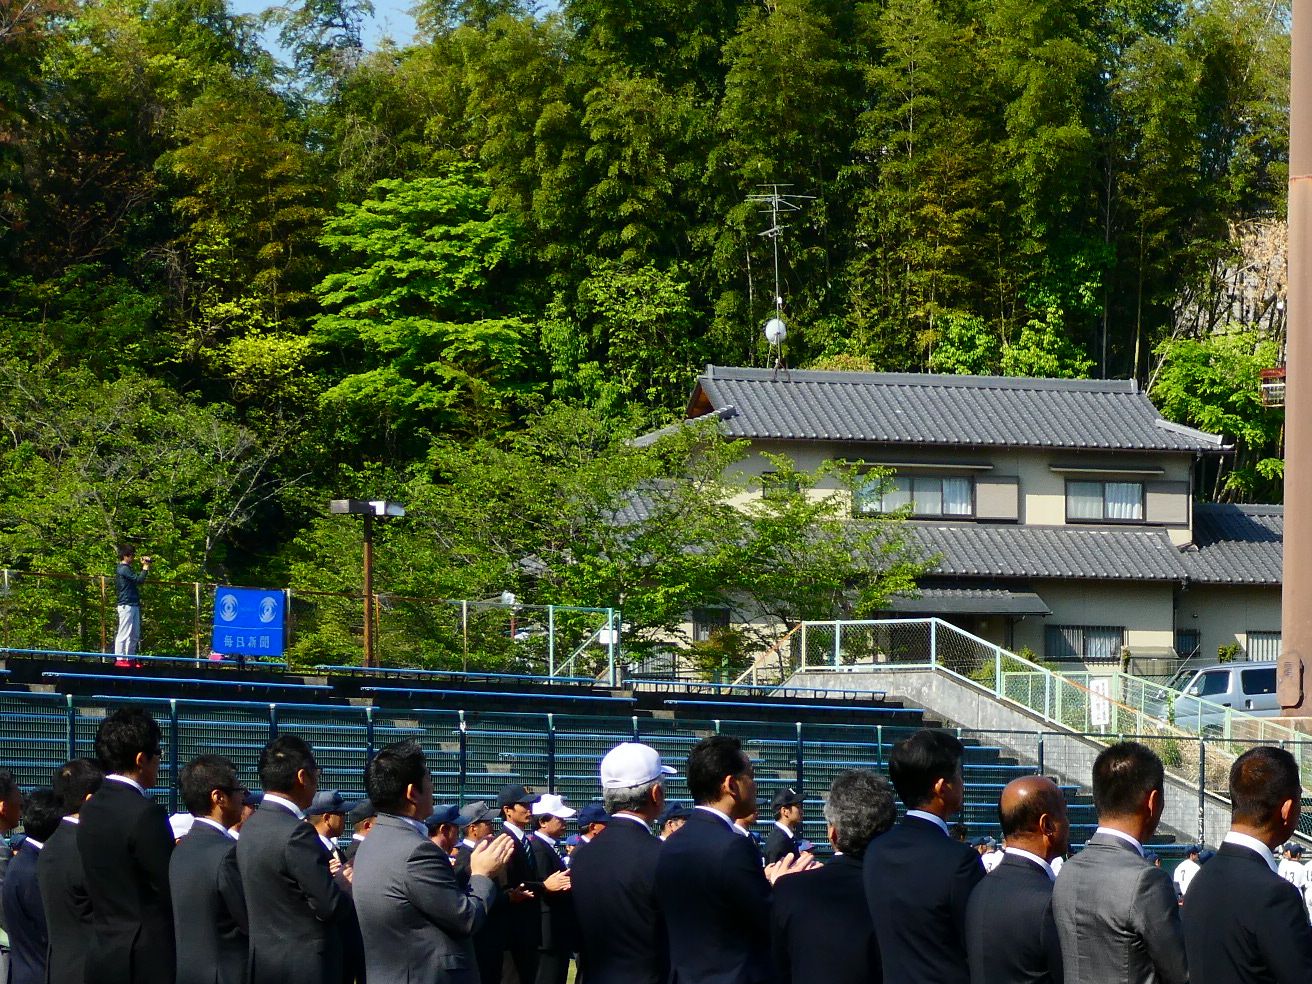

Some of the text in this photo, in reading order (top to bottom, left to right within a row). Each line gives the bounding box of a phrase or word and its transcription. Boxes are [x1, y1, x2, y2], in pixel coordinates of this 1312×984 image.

[223, 634, 270, 649] 毎日新聞
[1180, 869, 1186, 882] 7
